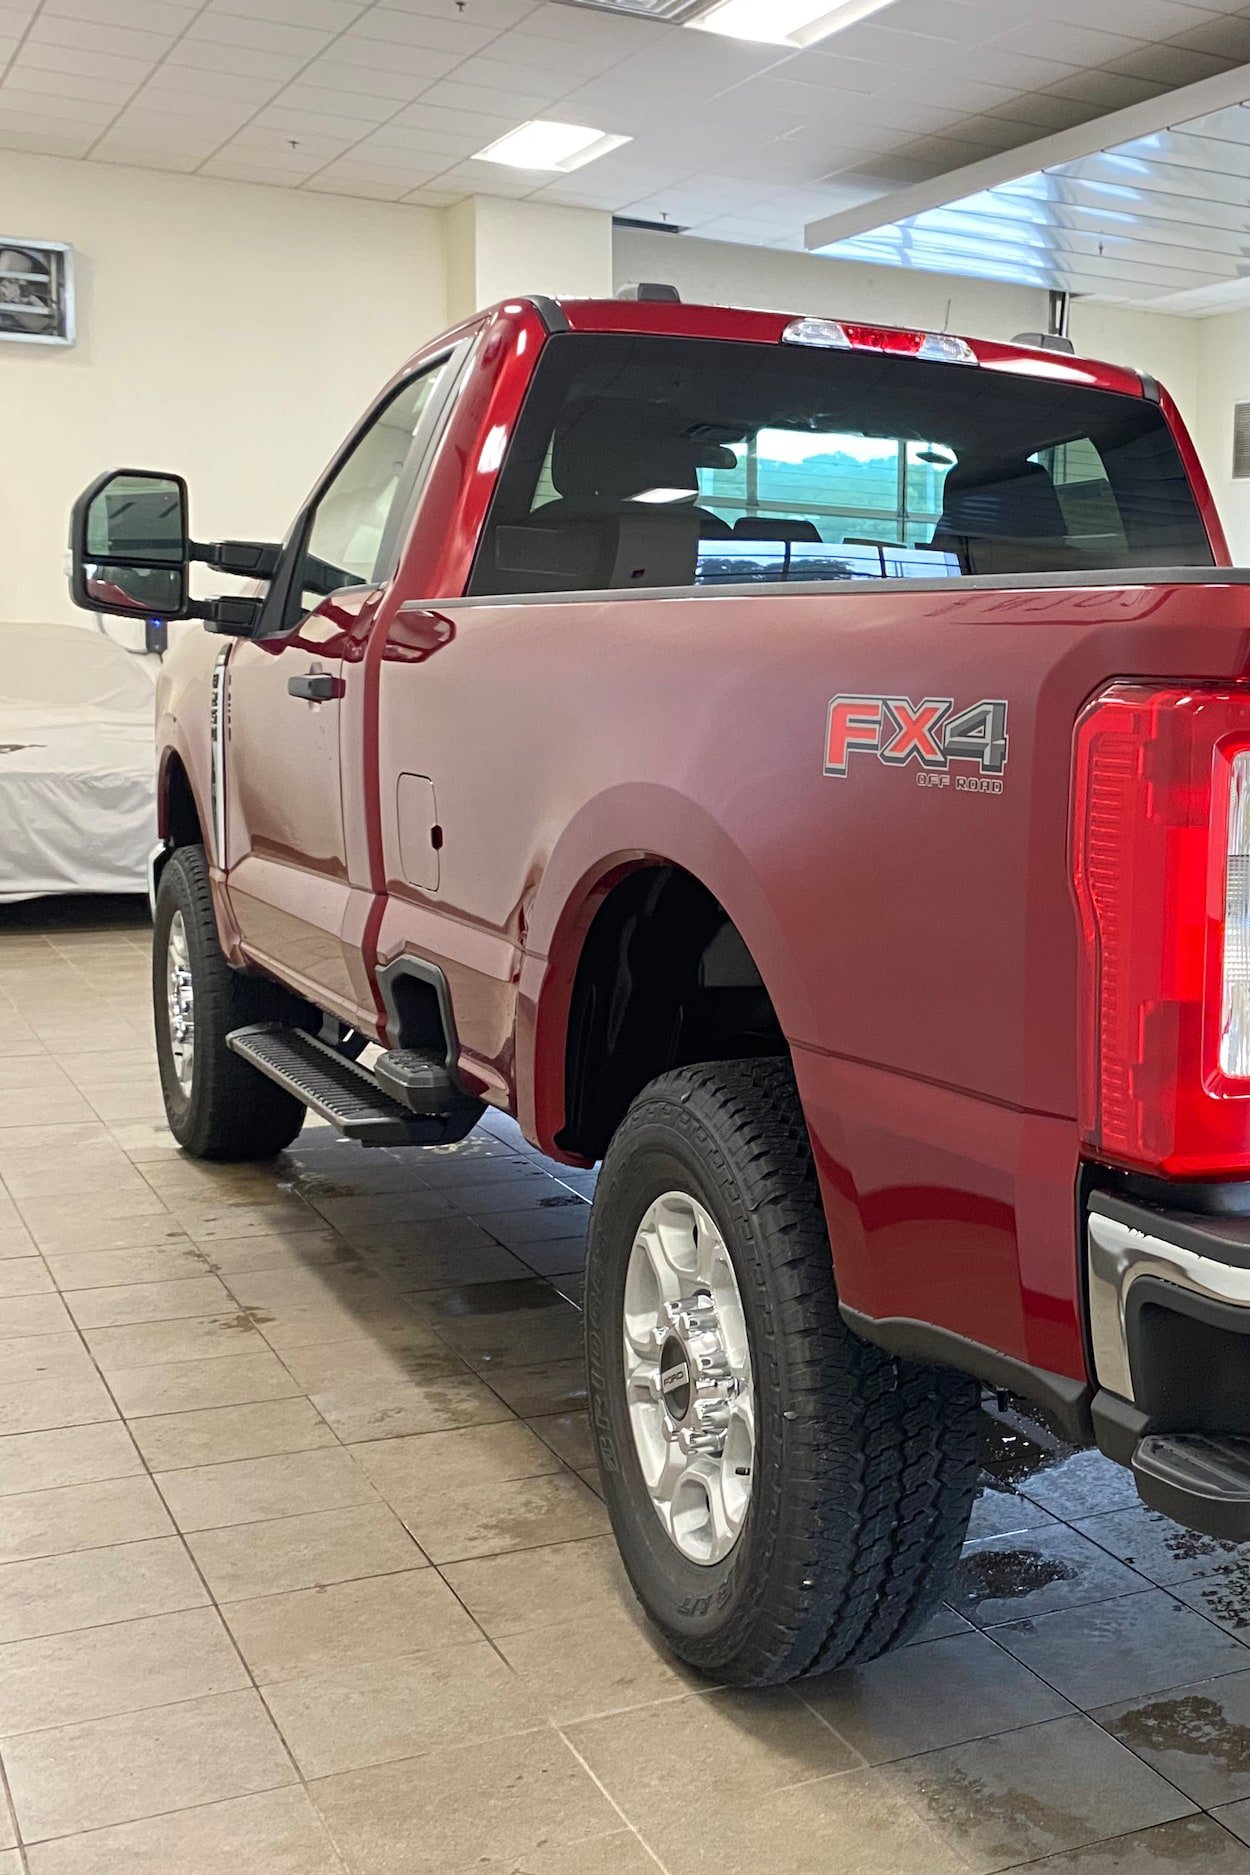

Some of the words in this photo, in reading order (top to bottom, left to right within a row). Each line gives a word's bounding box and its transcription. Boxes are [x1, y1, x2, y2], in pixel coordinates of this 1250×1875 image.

[823, 693, 1009, 778] FX4
[916, 772, 950, 788] OFF
[955, 776, 1004, 794] ROAD
